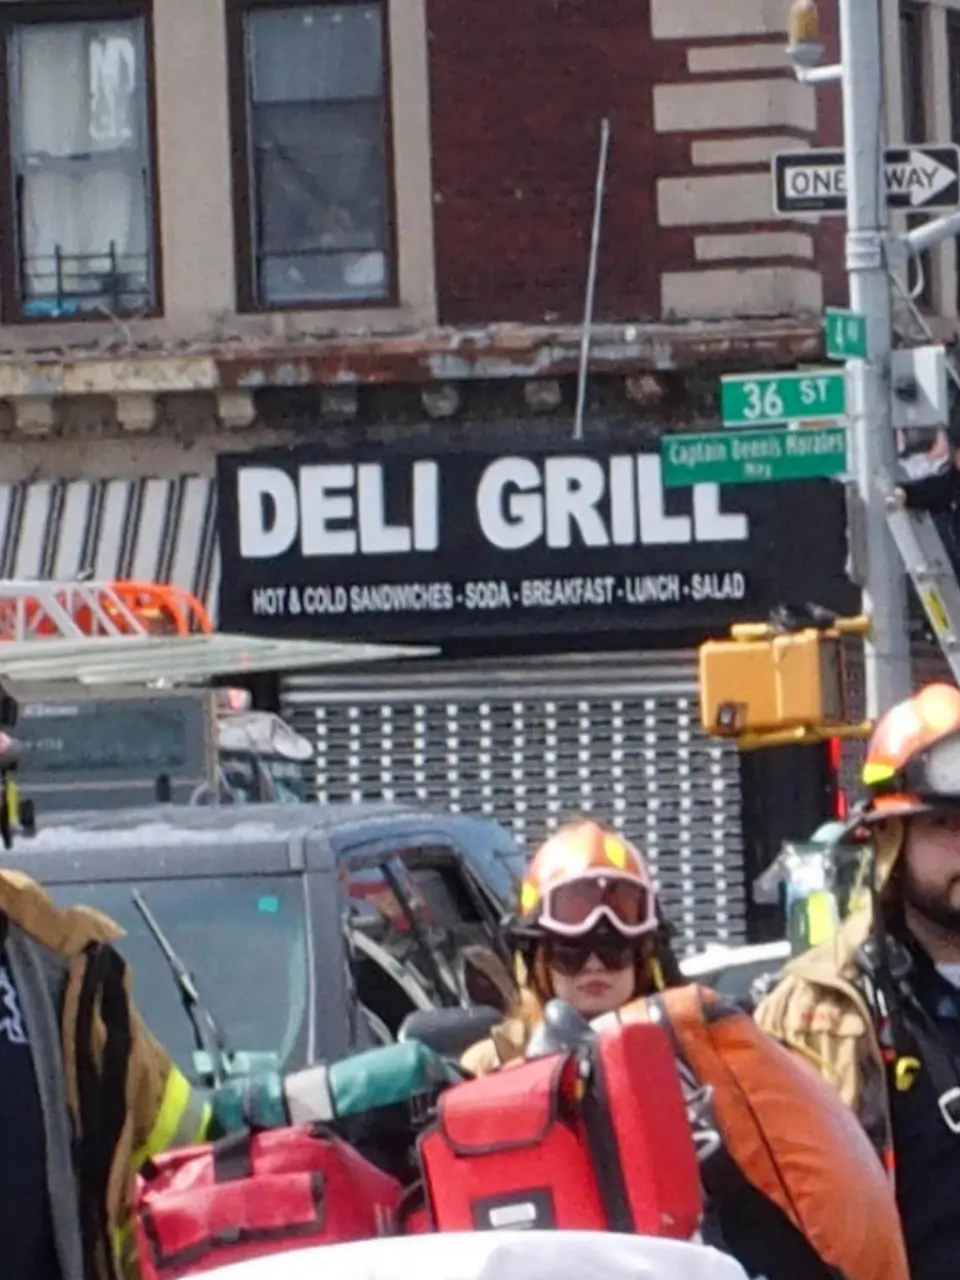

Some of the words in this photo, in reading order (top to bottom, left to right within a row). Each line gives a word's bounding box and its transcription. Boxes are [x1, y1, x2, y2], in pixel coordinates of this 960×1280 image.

[791, 169, 847, 195] ONE
[884, 165, 939, 190] WAY
[742, 383, 784, 419] 36
[799, 378, 829, 404] ST
[669, 440, 727, 468] Captain
[238, 460, 439, 558] DELI
[477, 453, 749, 550] GRILL
[253, 587, 285, 615] HOT
[289, 587, 301, 615] &
[303, 585, 348, 614] COLD
[350, 582, 454, 613] SANDWICHES
[465, 580, 512, 609] SODA
[521, 576, 615, 607] BREAKFAST
[625, 575, 680, 604] LUNCH
[691, 572, 745, 601] SALAD
